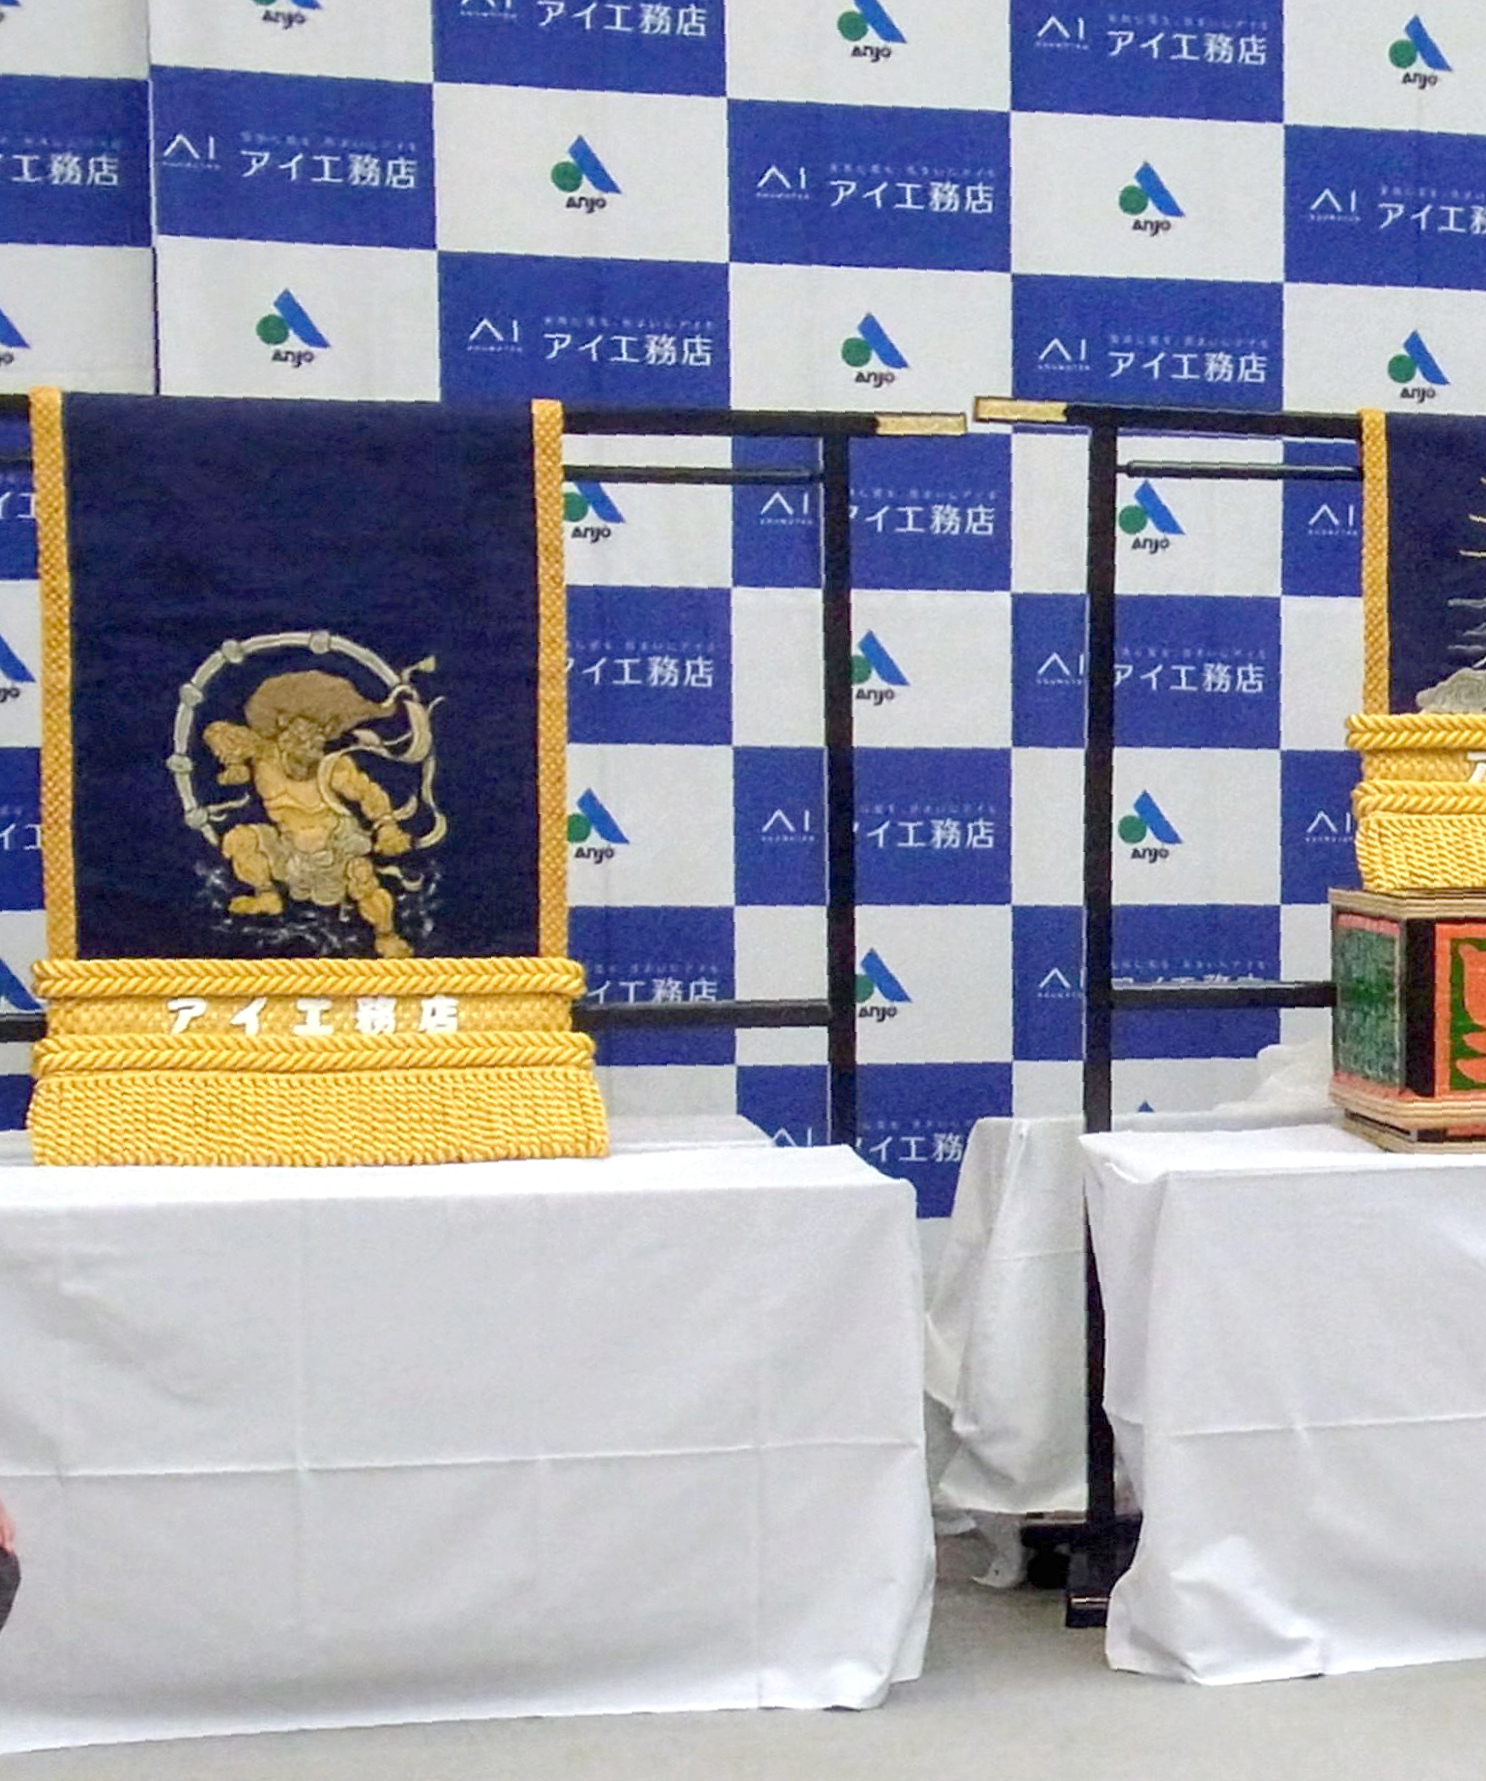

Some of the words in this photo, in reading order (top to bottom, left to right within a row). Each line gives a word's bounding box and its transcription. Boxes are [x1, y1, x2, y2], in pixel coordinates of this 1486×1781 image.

[537, 0, 706, 36] アイ工務店
[1108, 31, 1266, 65] アイ工務店
[0, 150, 118, 186] 工務店
[241, 149, 417, 189] アイ工務店
[830, 181, 993, 213] アイ工務店
[544, 334, 711, 366] アイ工務店
[1109, 352, 1266, 382] アイ工務店
[849, 503, 995, 536] イ工務店
[565, 656, 714, 688] イ工務店
[166, 996, 460, 1035] アイ工務店
